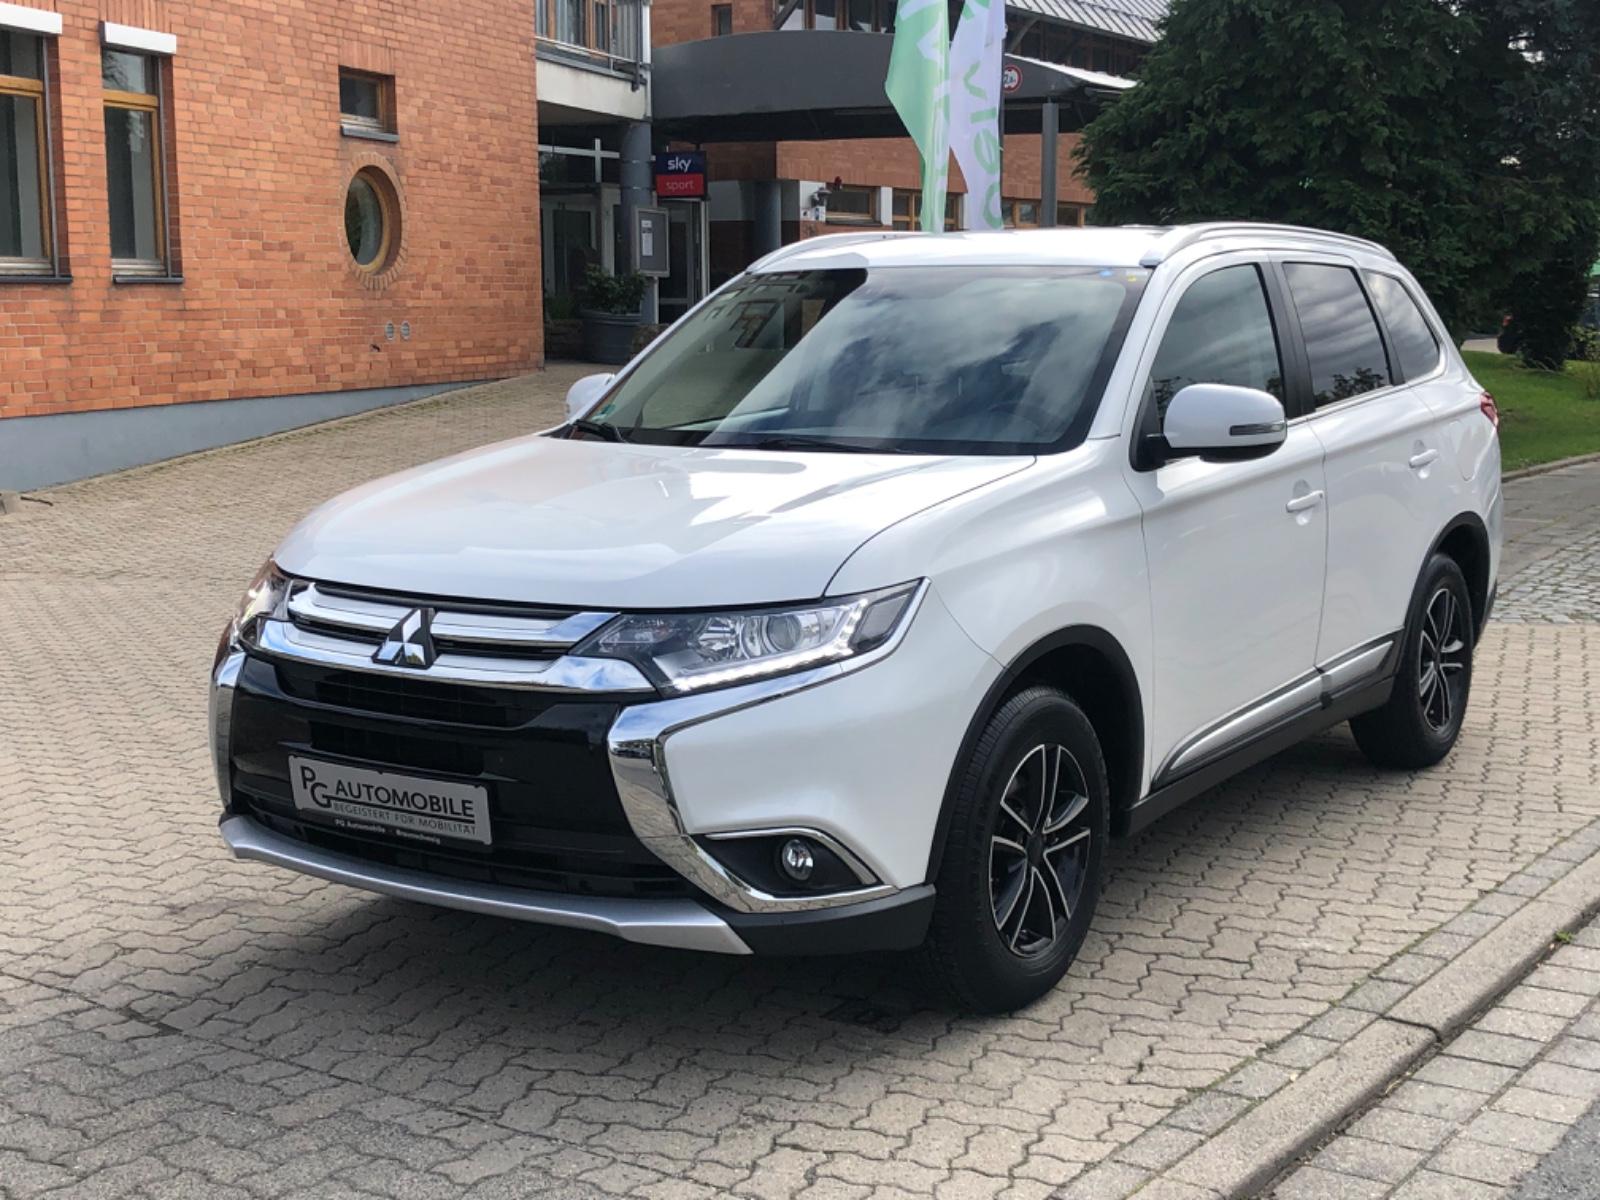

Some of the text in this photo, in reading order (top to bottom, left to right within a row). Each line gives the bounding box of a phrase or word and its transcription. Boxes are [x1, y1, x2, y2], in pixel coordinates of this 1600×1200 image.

[667, 156, 692, 172] sky
[666, 180, 694, 191] sport
[335, 779, 475, 818] AUTOMOBILE
[333, 802, 390, 822] BEGEISTERT
